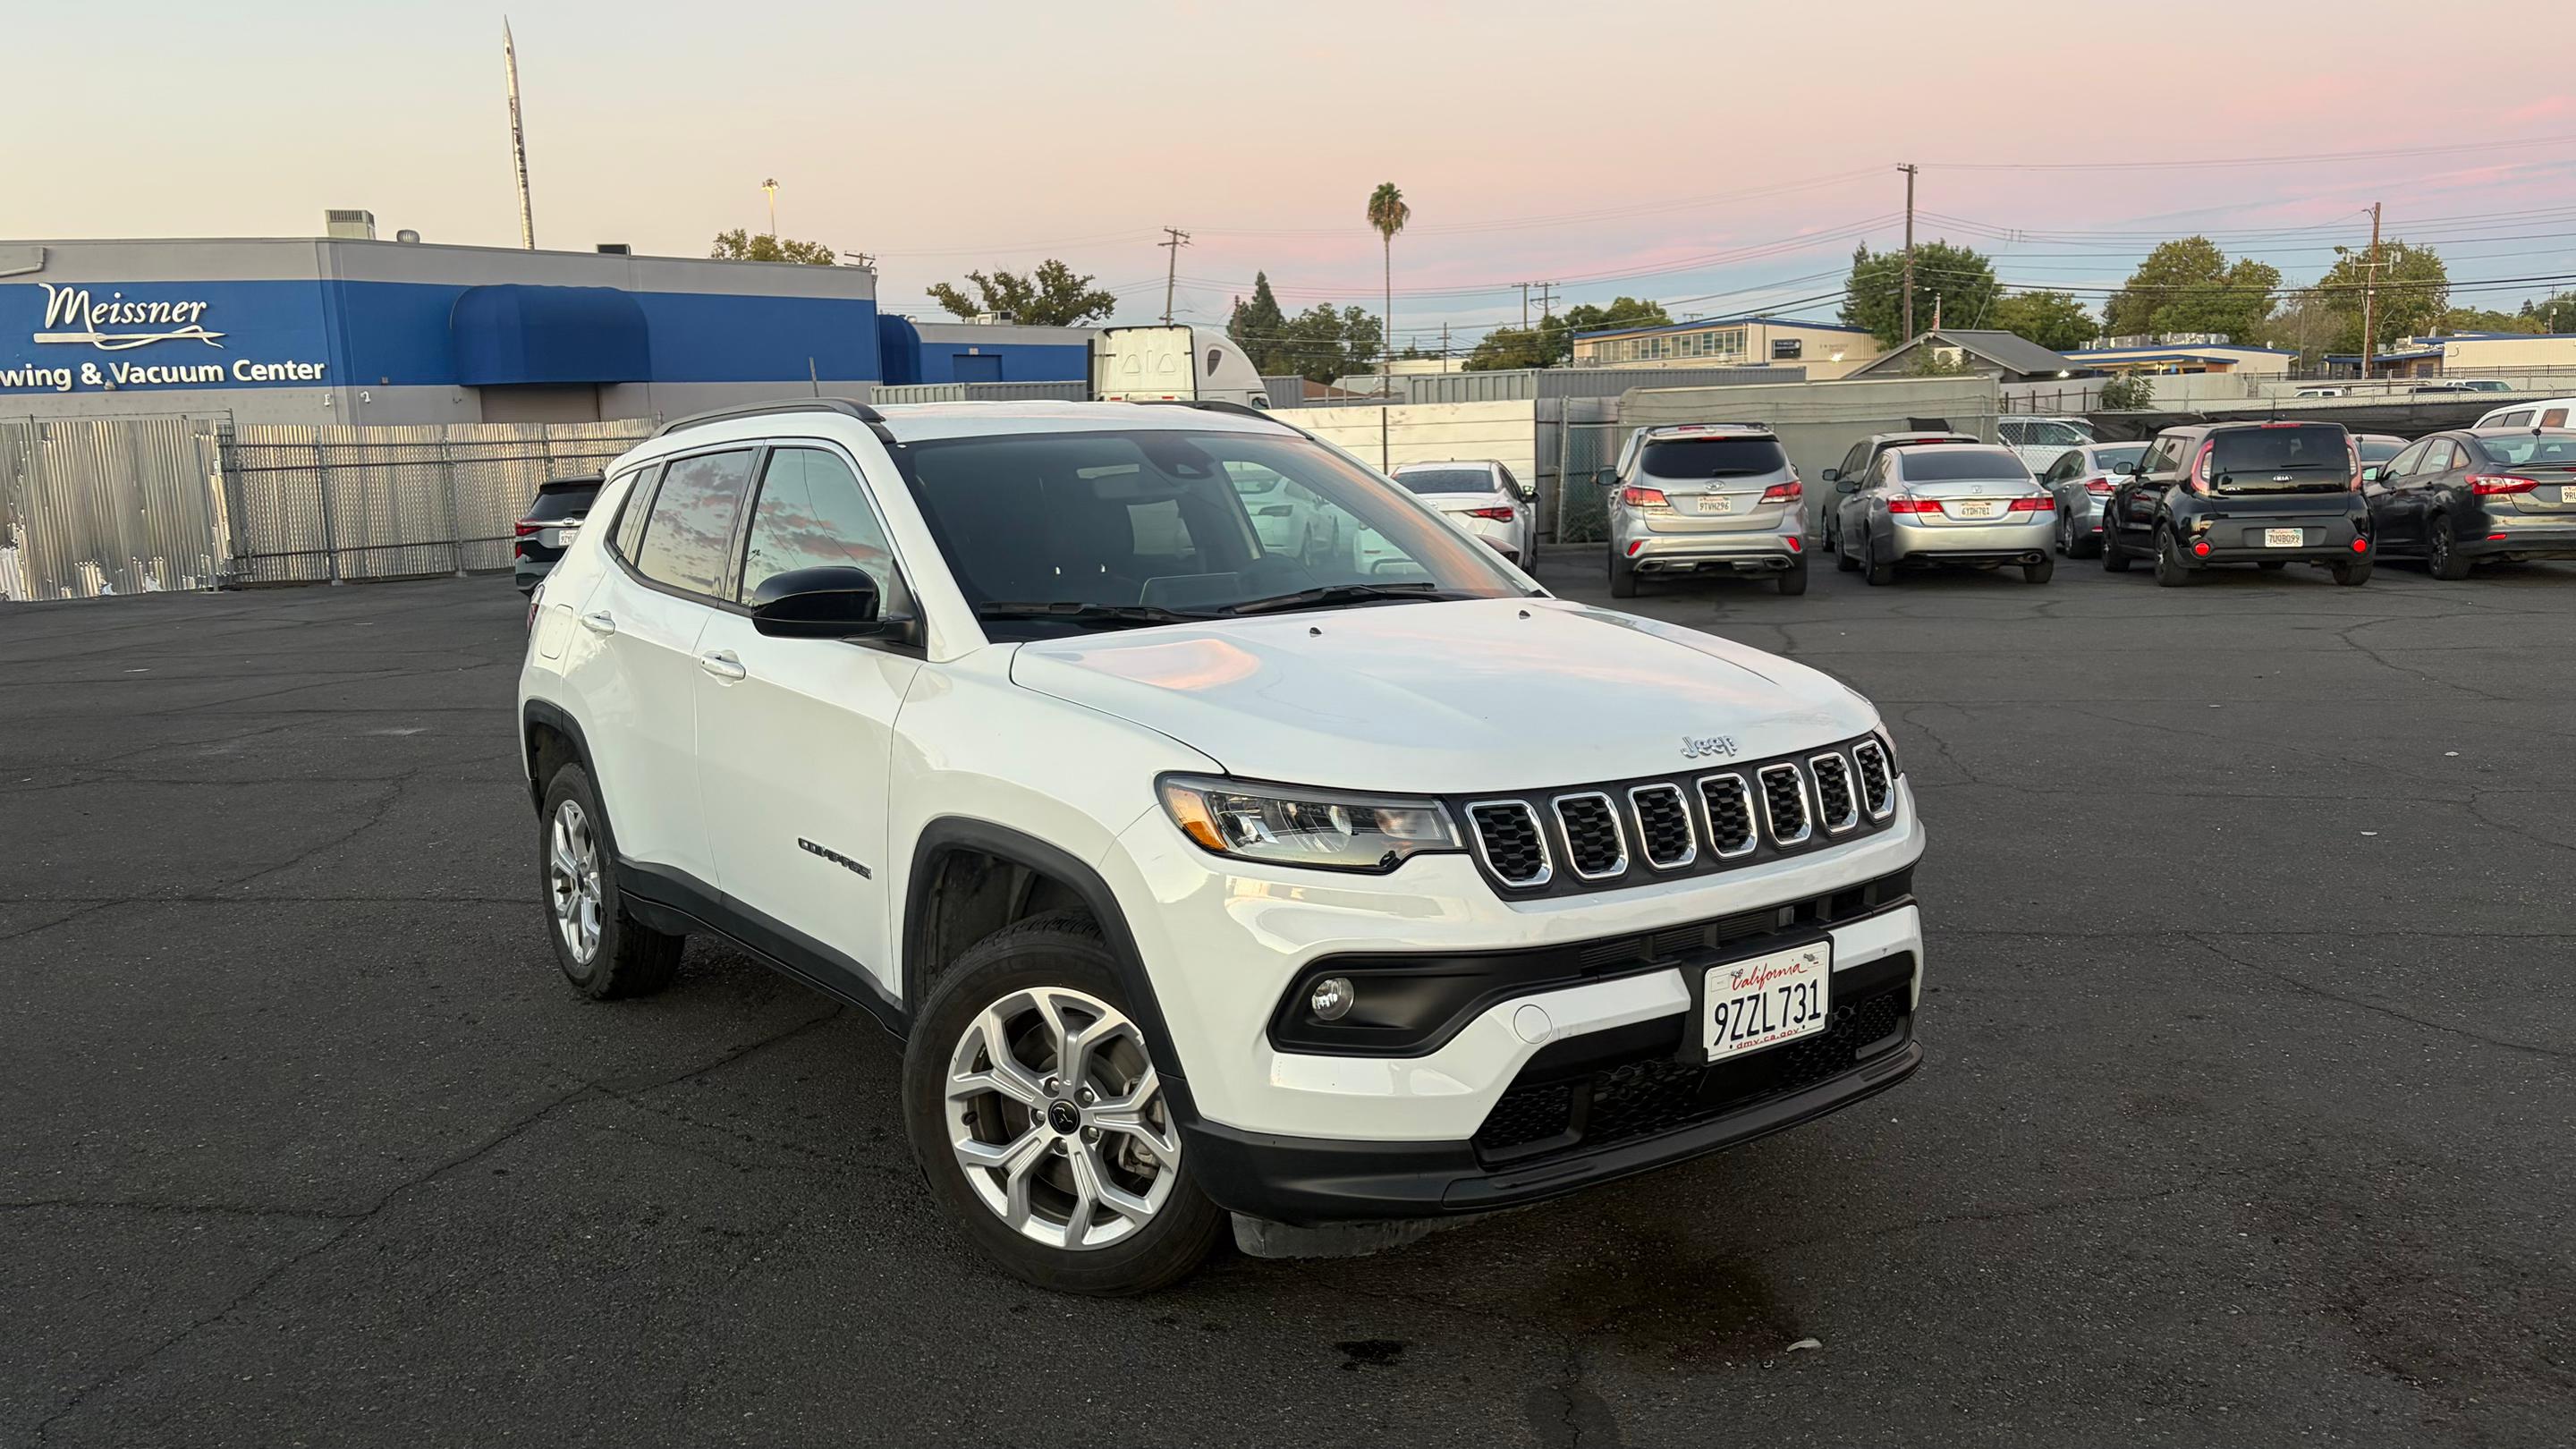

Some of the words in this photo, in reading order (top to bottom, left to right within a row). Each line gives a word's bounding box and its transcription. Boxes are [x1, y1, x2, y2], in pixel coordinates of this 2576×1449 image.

[38, 283, 208, 335] Meissner
[80, 363, 103, 385] &
[108, 360, 224, 384] Vacuum
[233, 360, 325, 382] Center
[1681, 735, 1738, 758] Jeep
[1731, 959, 1809, 991] California
[1736, 1028, 1801, 1050] dmv.ca.gov
